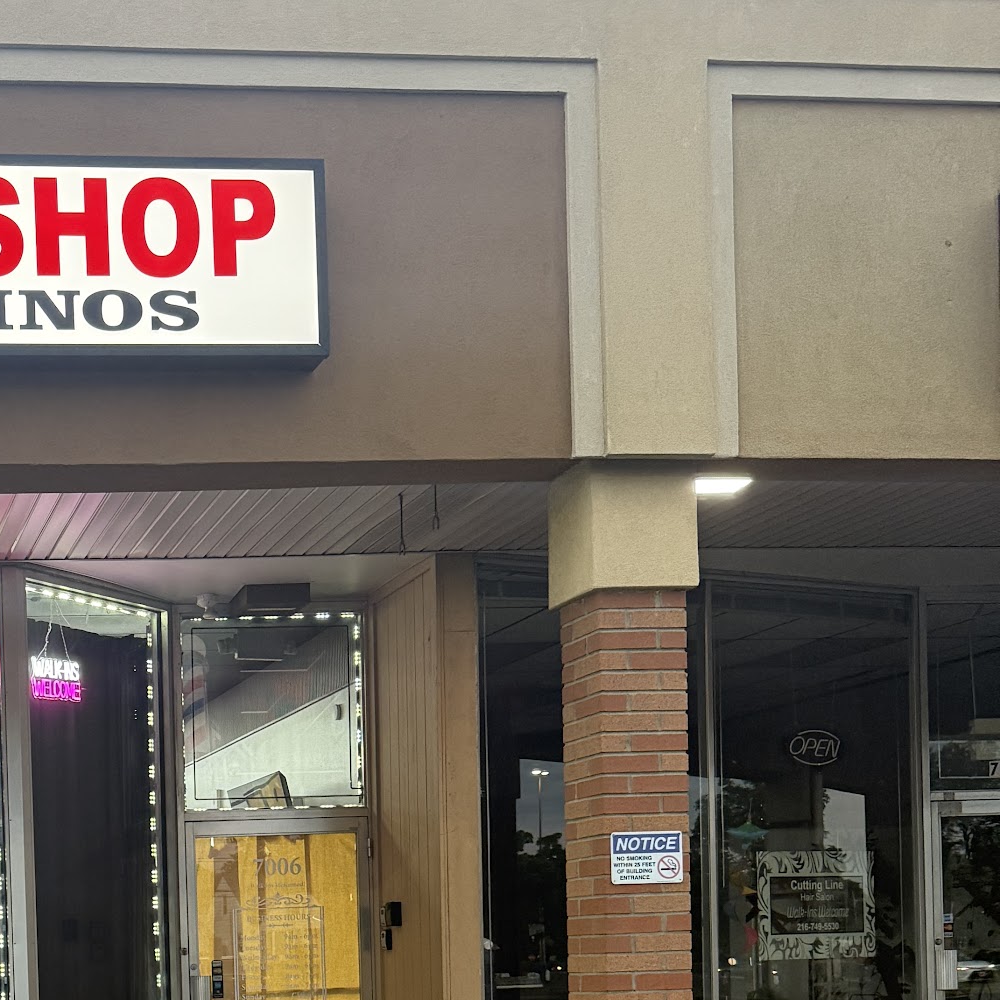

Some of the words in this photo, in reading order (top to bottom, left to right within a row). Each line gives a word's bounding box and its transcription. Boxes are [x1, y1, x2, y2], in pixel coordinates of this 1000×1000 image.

[31, 656, 80, 681] WALK-INS
[31, 677, 81, 700] WELCOME
[789, 736, 840, 758] OPEN
[615, 836, 678, 852] NOTICE
[253, 857, 302, 876] 7006
[790, 880, 823, 892] Cutting
[825, 880, 844, 890] Line
[800, 893, 815, 901] Hair
[815, 893, 835, 901] Salon
[247, 914, 282, 923] BINESS
